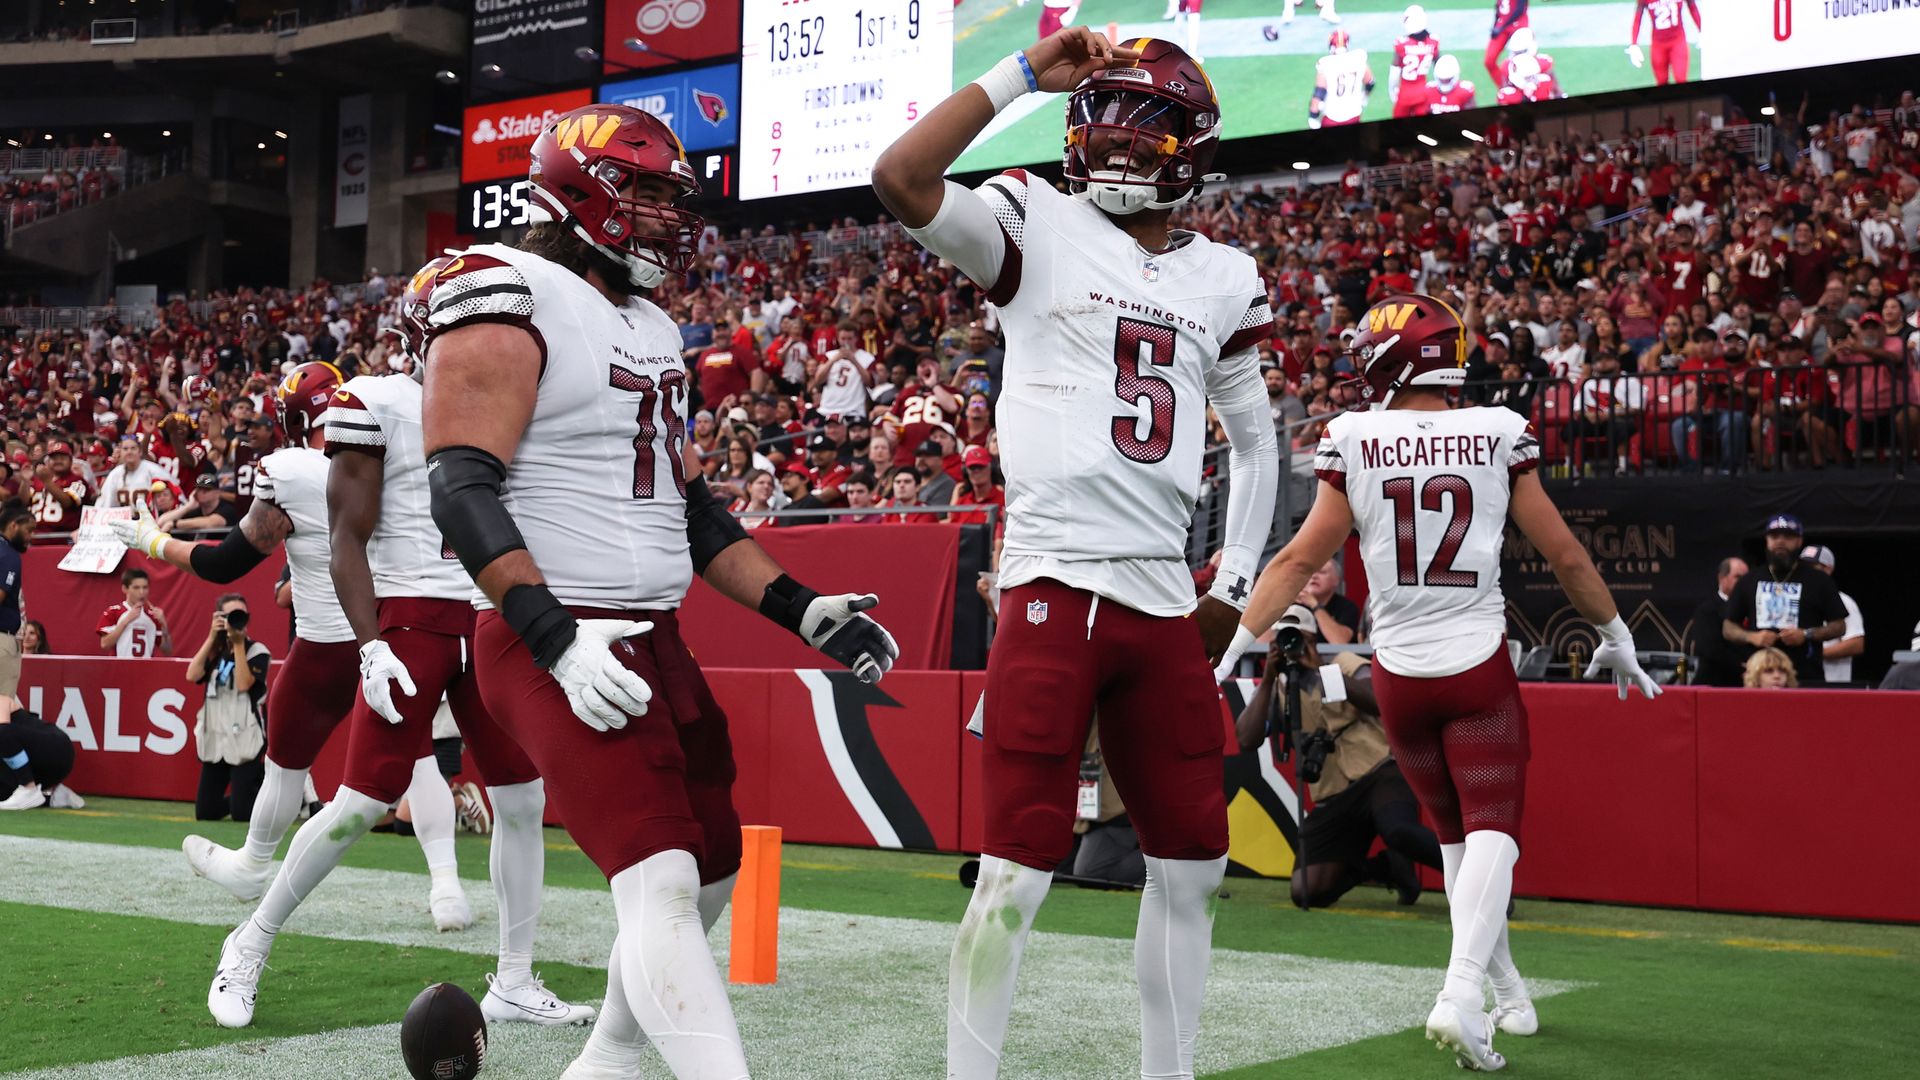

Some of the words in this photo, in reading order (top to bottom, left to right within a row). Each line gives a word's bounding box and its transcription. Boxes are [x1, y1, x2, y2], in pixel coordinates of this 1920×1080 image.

[855, 9, 885, 48] 1ST
[908, 0, 920, 40] 9
[768, 16, 825, 62] 13:52
[1108, 69, 1145, 79] COMMANDERS
[1336, 72, 1358, 98] 67
[1165, 84, 1187, 97] OAKLEY
[816, 114, 872, 128] RUSHNG
[907, 102, 918, 120] 5
[771, 122, 782, 139] 8
[497, 144, 529, 163] STAD
[772, 148, 781, 166] 7
[816, 141, 870, 154] PASSNG
[772, 174, 779, 193] 1
[473, 181, 529, 230] 13:5
[1672, 260, 1692, 290] 7
[1089, 291, 1207, 334] WASHINGTON
[612, 344, 676, 366] WASHINGTON
[836, 366, 851, 388] 5
[1111, 316, 1178, 464] 5
[902, 395, 944, 425] 26
[1361, 435, 1501, 469] McCAFFREY
[238, 464, 257, 496] 2
[1382, 474, 1478, 588] 12
[1503, 523, 1676, 560] MRGAN
[1615, 561, 1662, 574] CLUB
[132, 629, 147, 657] 5
